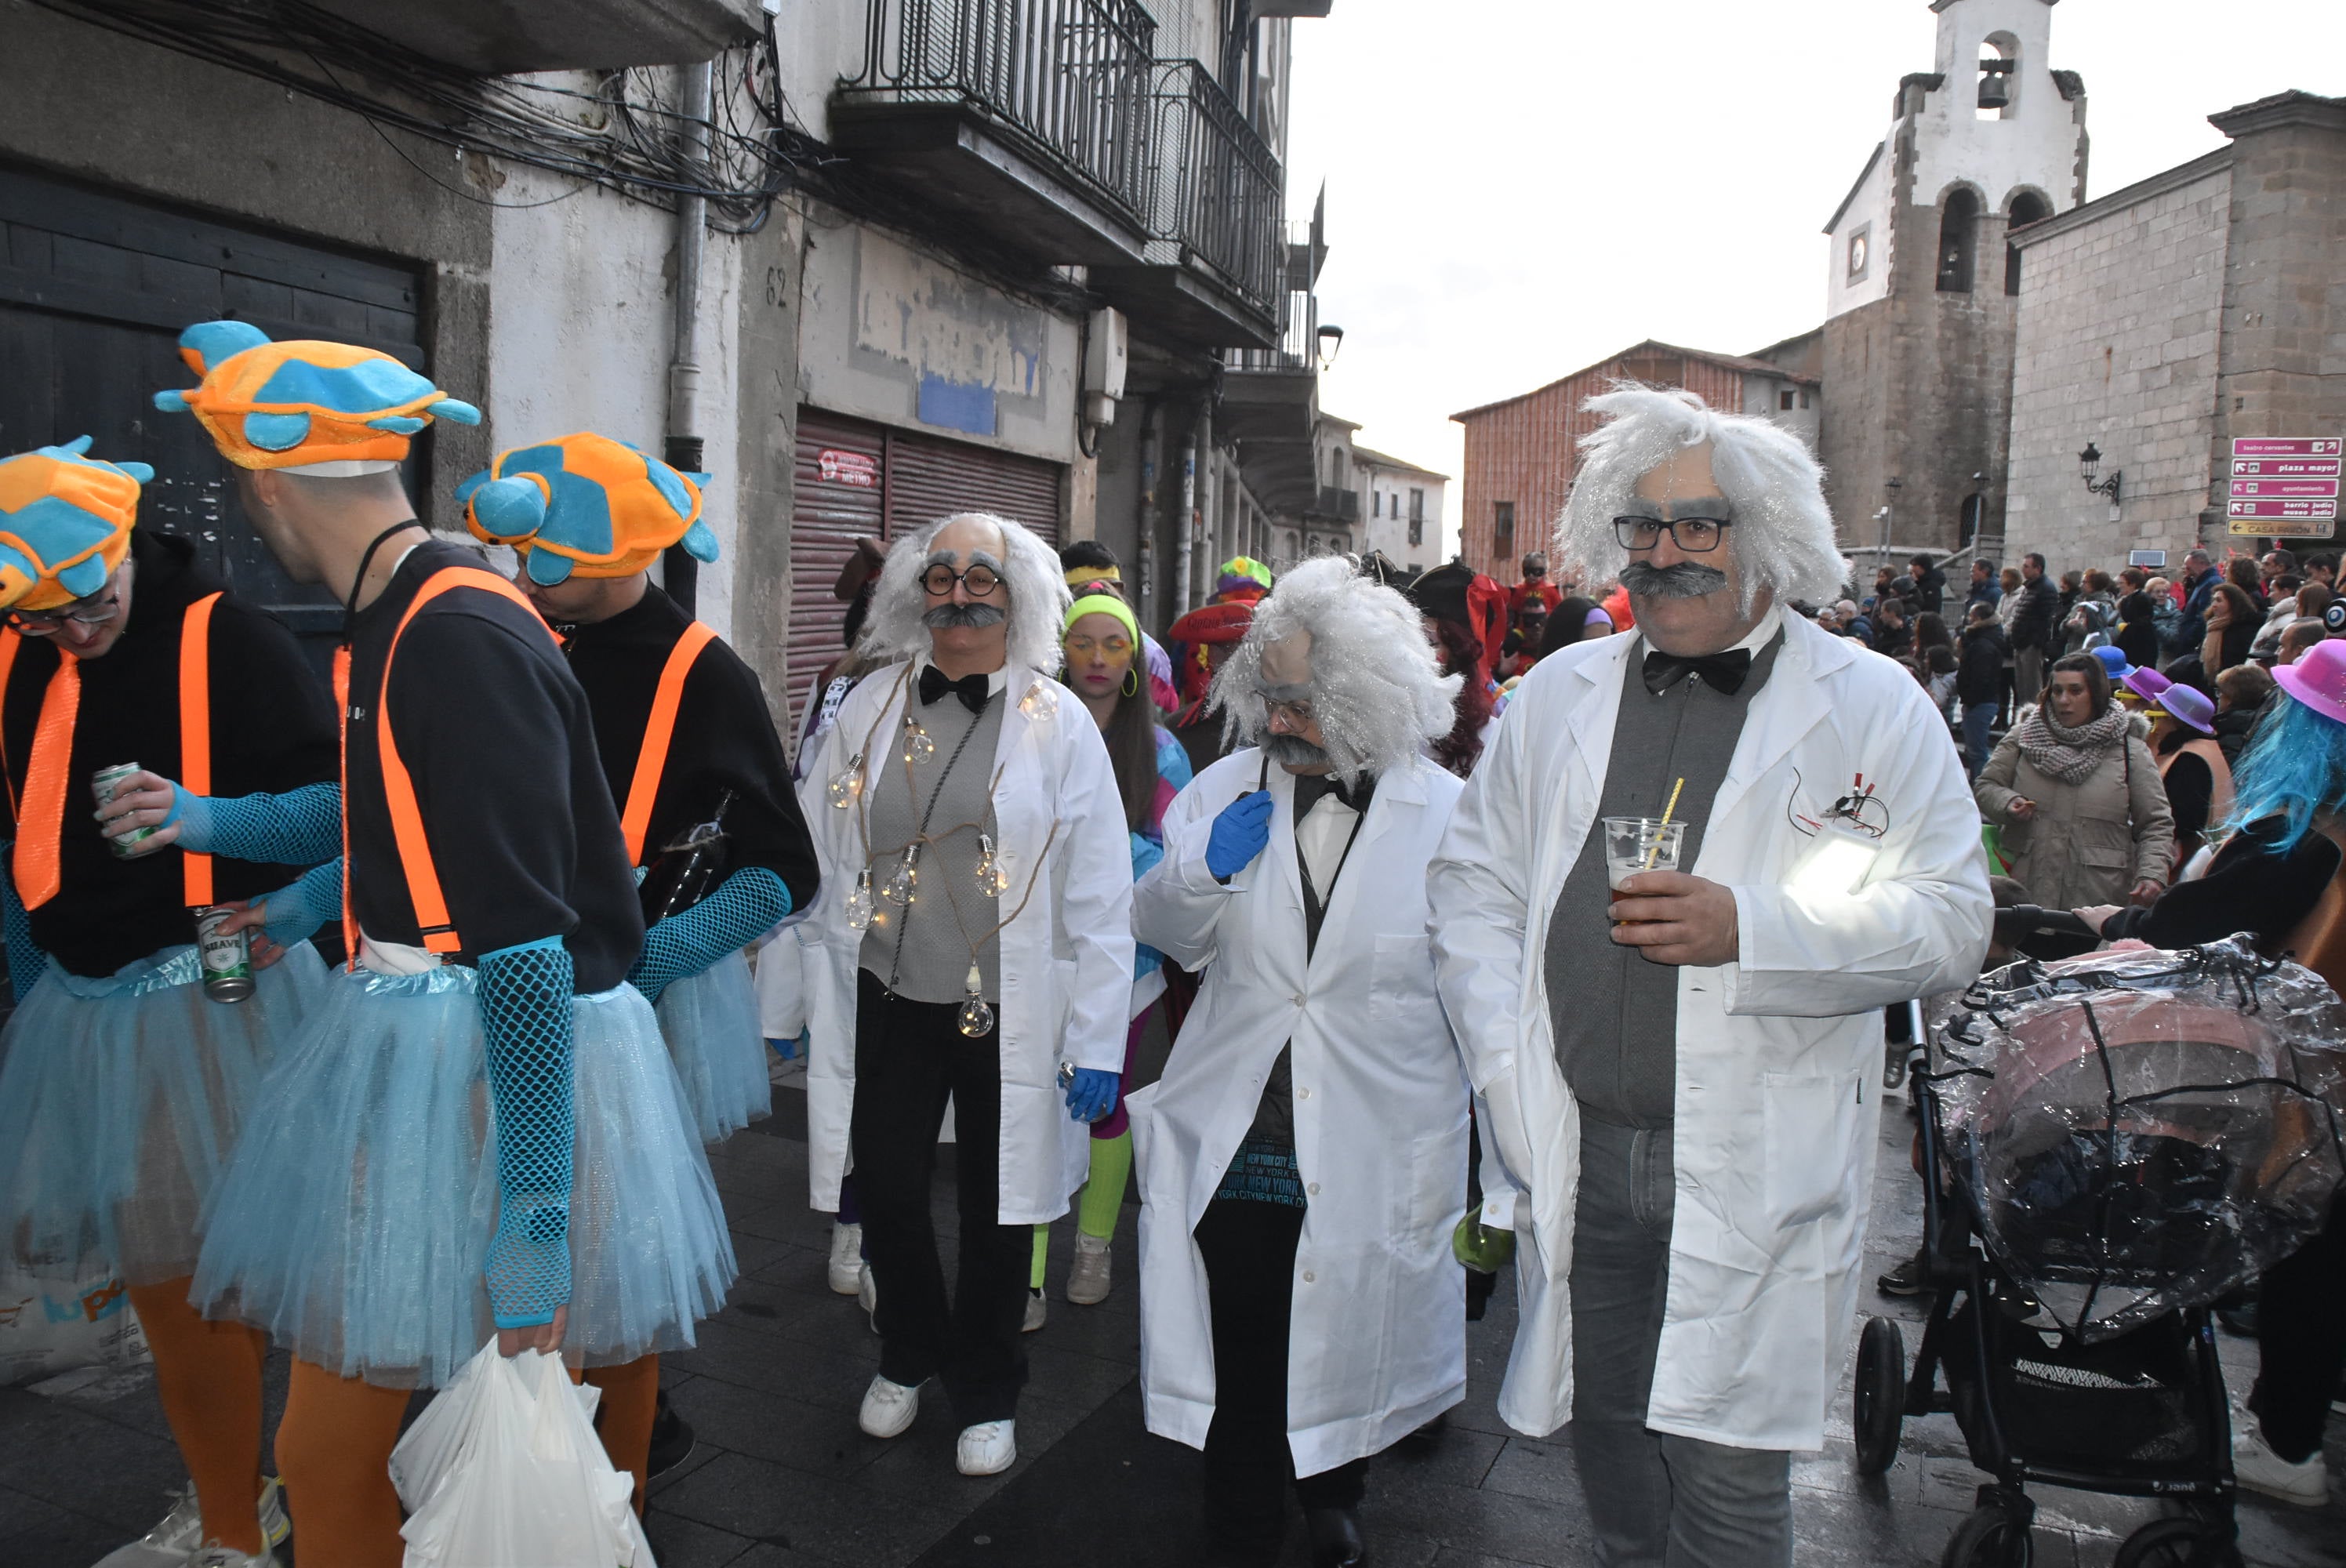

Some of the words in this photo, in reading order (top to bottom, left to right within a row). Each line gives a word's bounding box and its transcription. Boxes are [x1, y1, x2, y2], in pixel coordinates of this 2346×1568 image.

[766, 266, 787, 308] 62
[1247, 1153, 1260, 1163] NEW
[1260, 1154, 1274, 1165] YORK
[1275, 1156, 1287, 1166] CITY
[1246, 1166, 1264, 1175] NEW
[1266, 1168, 1289, 1177] YORK
[1248, 1175, 1273, 1192] NEW
[1273, 1178, 1298, 1196] YORK
[1273, 1193, 1294, 1206] YORK
